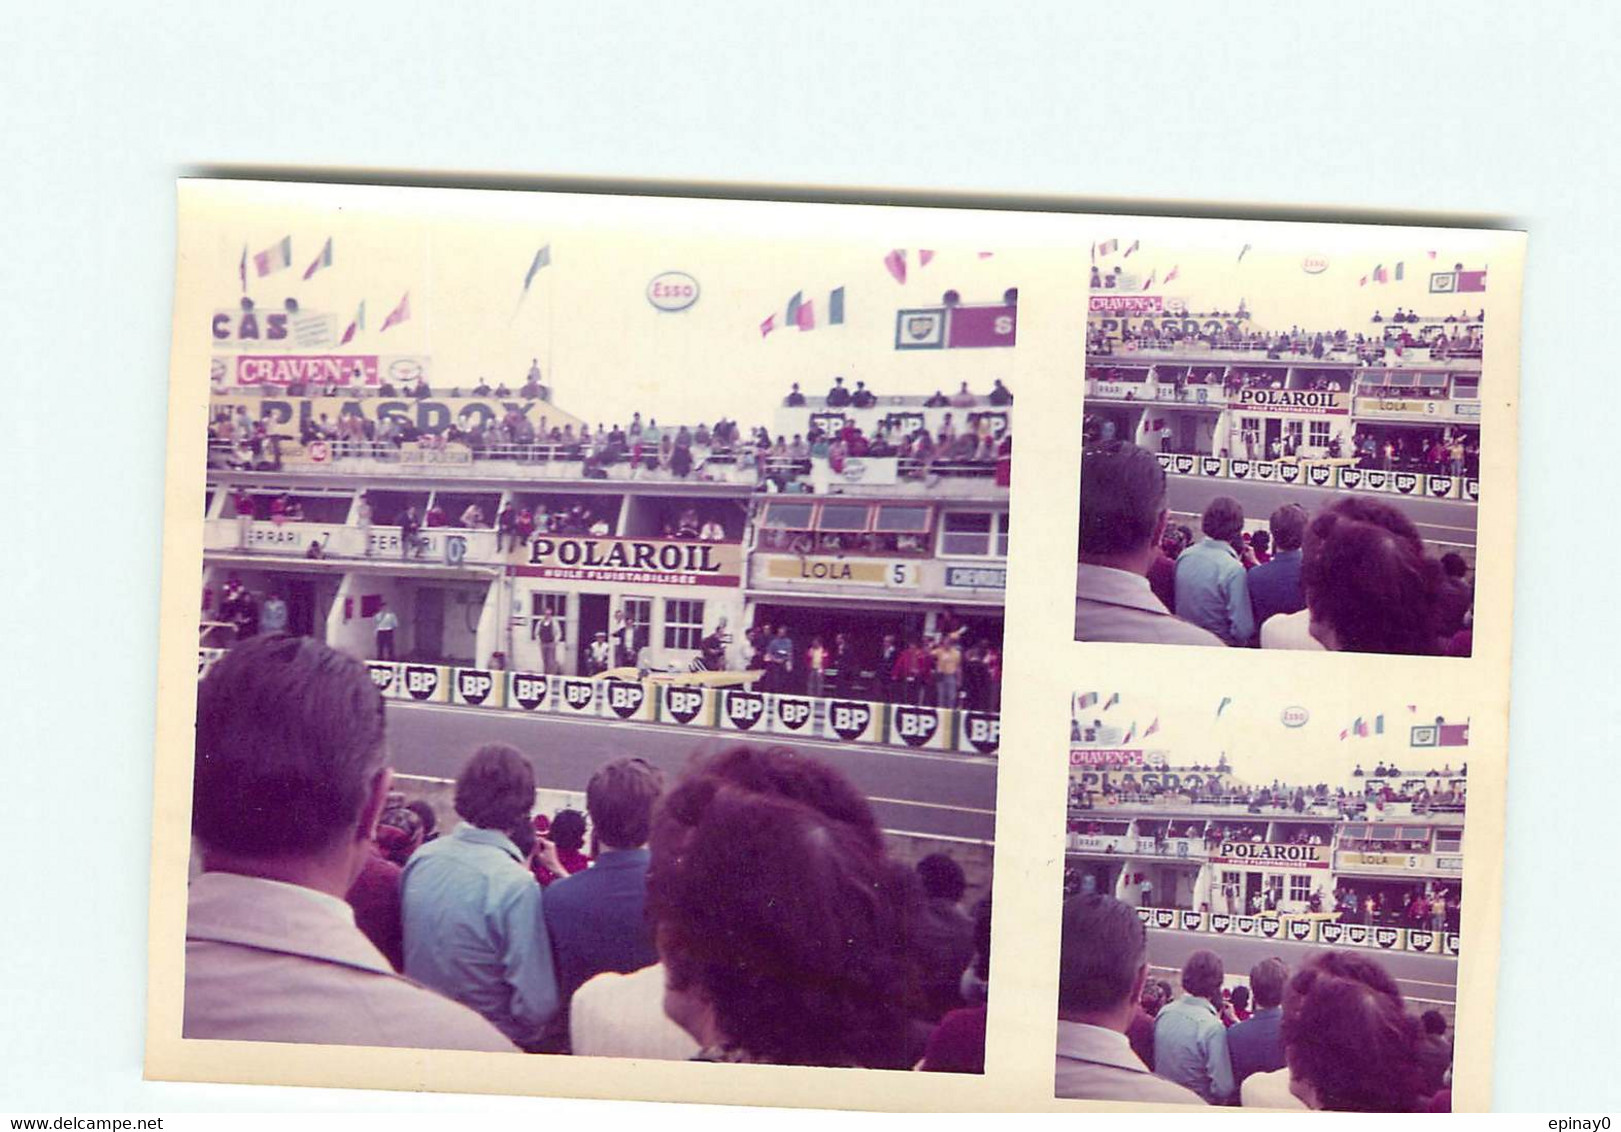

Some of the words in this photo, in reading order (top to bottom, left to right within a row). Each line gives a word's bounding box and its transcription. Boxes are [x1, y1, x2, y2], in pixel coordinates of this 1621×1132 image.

[653, 282, 692, 297] Esso
[1239, 390, 1340, 408] POLAROIL
[1380, 402, 1408, 411] LOLA
[1178, 458, 1192, 470] BP
[1206, 460, 1221, 471] BP
[1234, 462, 1249, 474] BP
[1260, 465, 1273, 475] BP
[1283, 466, 1298, 478] BP
[1313, 469, 1329, 481] BP
[1344, 472, 1361, 484] BP
[1371, 475, 1385, 486] BP
[1398, 477, 1416, 490] BP
[1432, 480, 1451, 492] BP
[529, 539, 722, 572] POLAROIL
[801, 559, 853, 580] LOLA
[893, 564, 907, 584] 5
[408, 671, 437, 693] BP
[462, 674, 492, 697] BP
[517, 679, 547, 701] BP
[567, 684, 592, 704] BP
[612, 686, 643, 709] BP
[670, 691, 702, 714] BP
[730, 697, 763, 720] BP
[782, 703, 808, 723] BP
[833, 707, 869, 731] BP
[901, 712, 937, 737] BP
[1220, 843, 1320, 861] POLAROIL
[1361, 855, 1388, 865] LOLA
[1158, 912, 1173, 924] BP
[1186, 914, 1201, 926] BP
[1214, 917, 1229, 929] BP
[1240, 919, 1253, 929] BP
[1263, 921, 1279, 933] BP
[1293, 924, 1309, 935] BP
[1324, 927, 1341, 939] BP
[1351, 930, 1366, 940] BP
[1379, 932, 1397, 944] BP
[1412, 935, 1432, 947] BP
